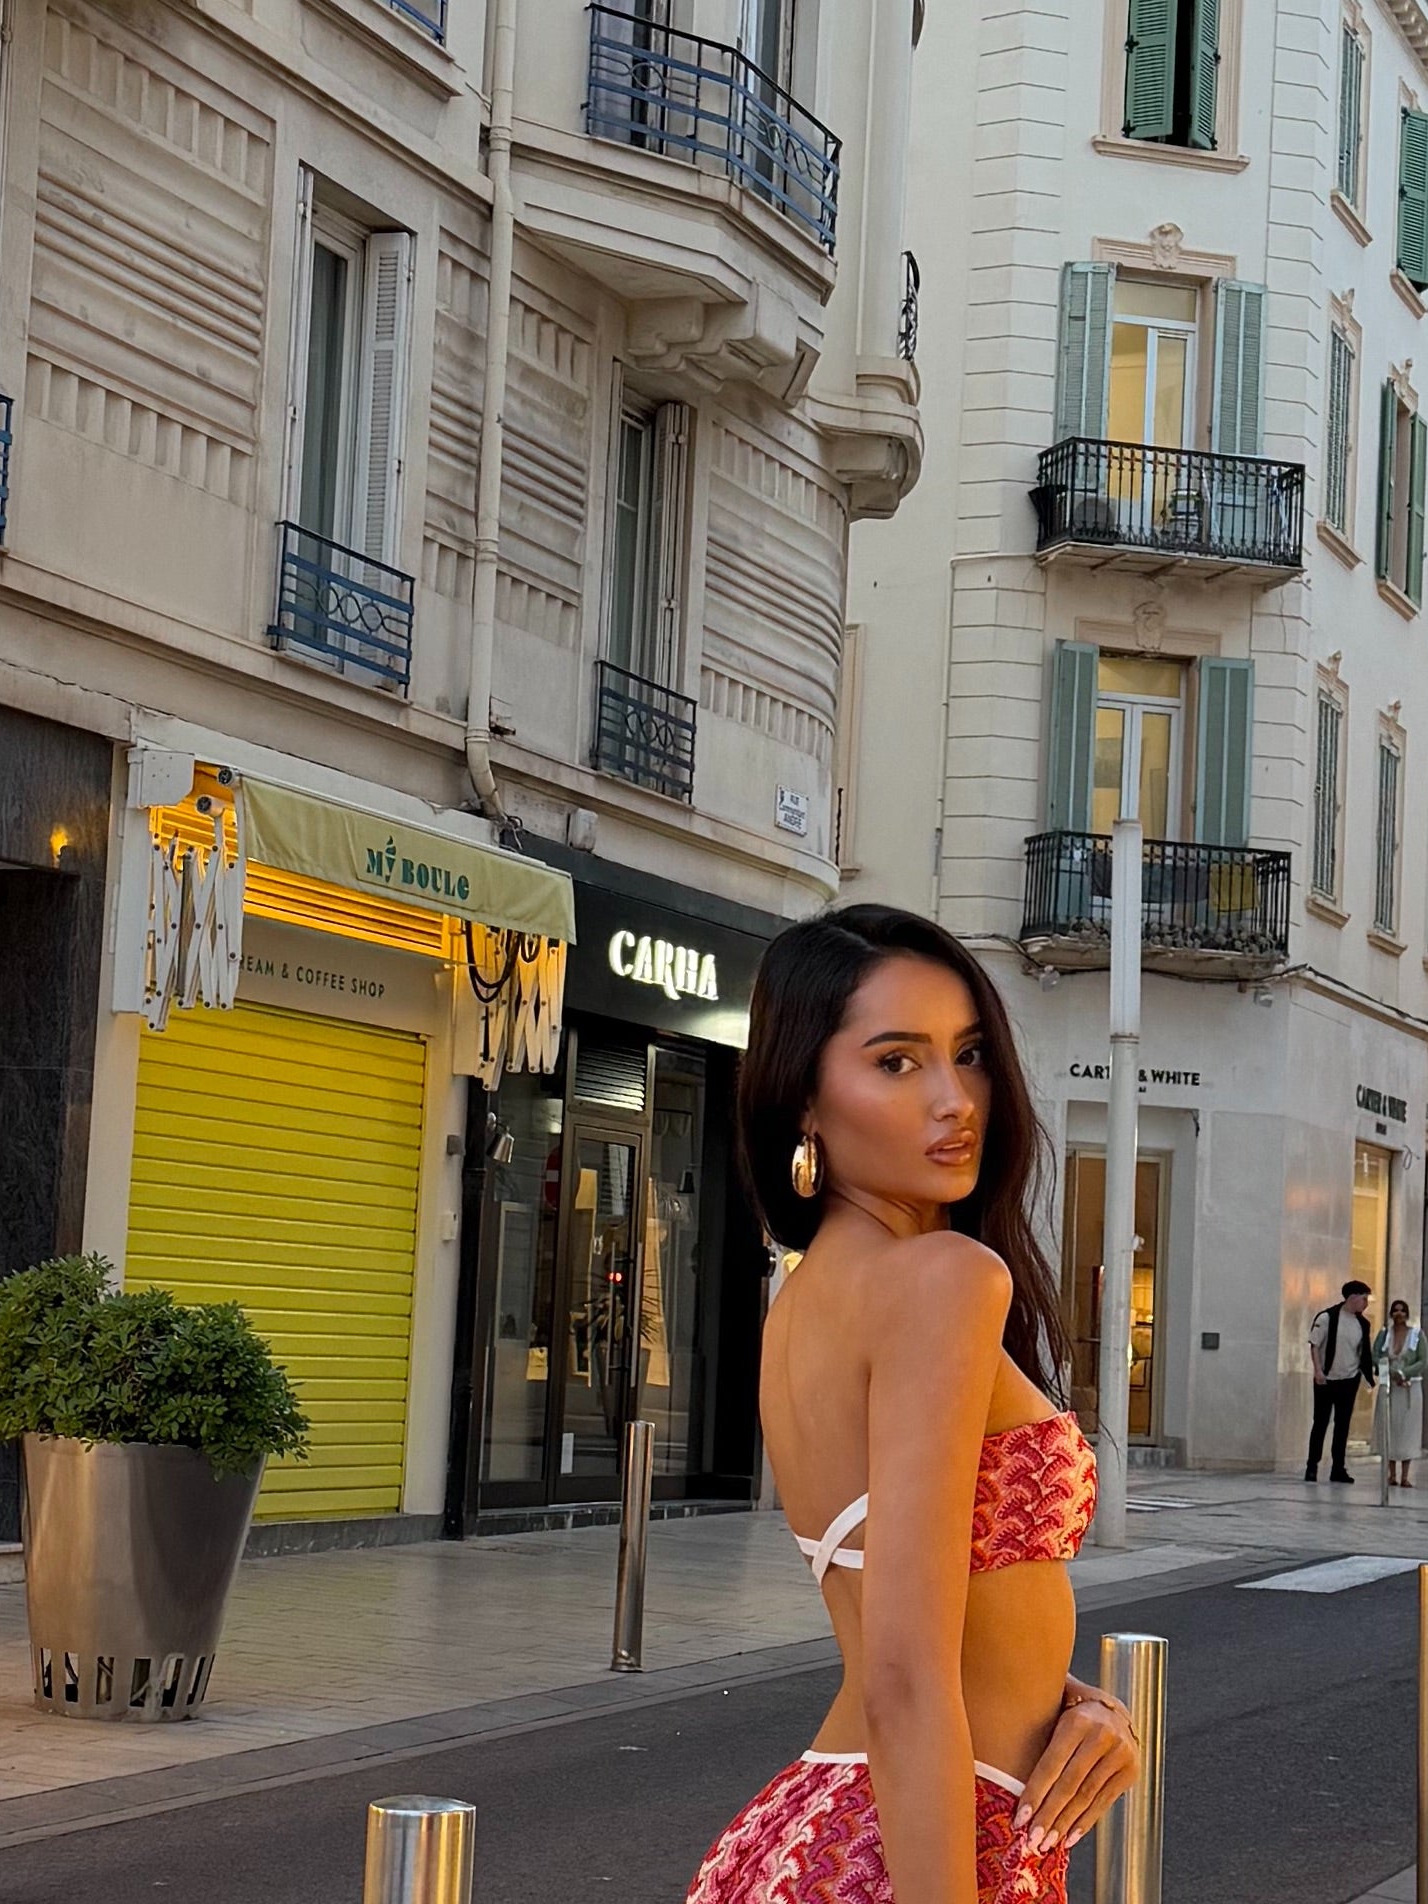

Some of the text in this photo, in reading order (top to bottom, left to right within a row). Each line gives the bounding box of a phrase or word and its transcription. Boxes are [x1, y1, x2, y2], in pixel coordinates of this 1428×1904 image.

[239, 954, 386, 999] REAM & COFFEE SHOP
[608, 929, 720, 1001] CARHA
[1069, 1063, 1201, 1086] CART & WHITE
